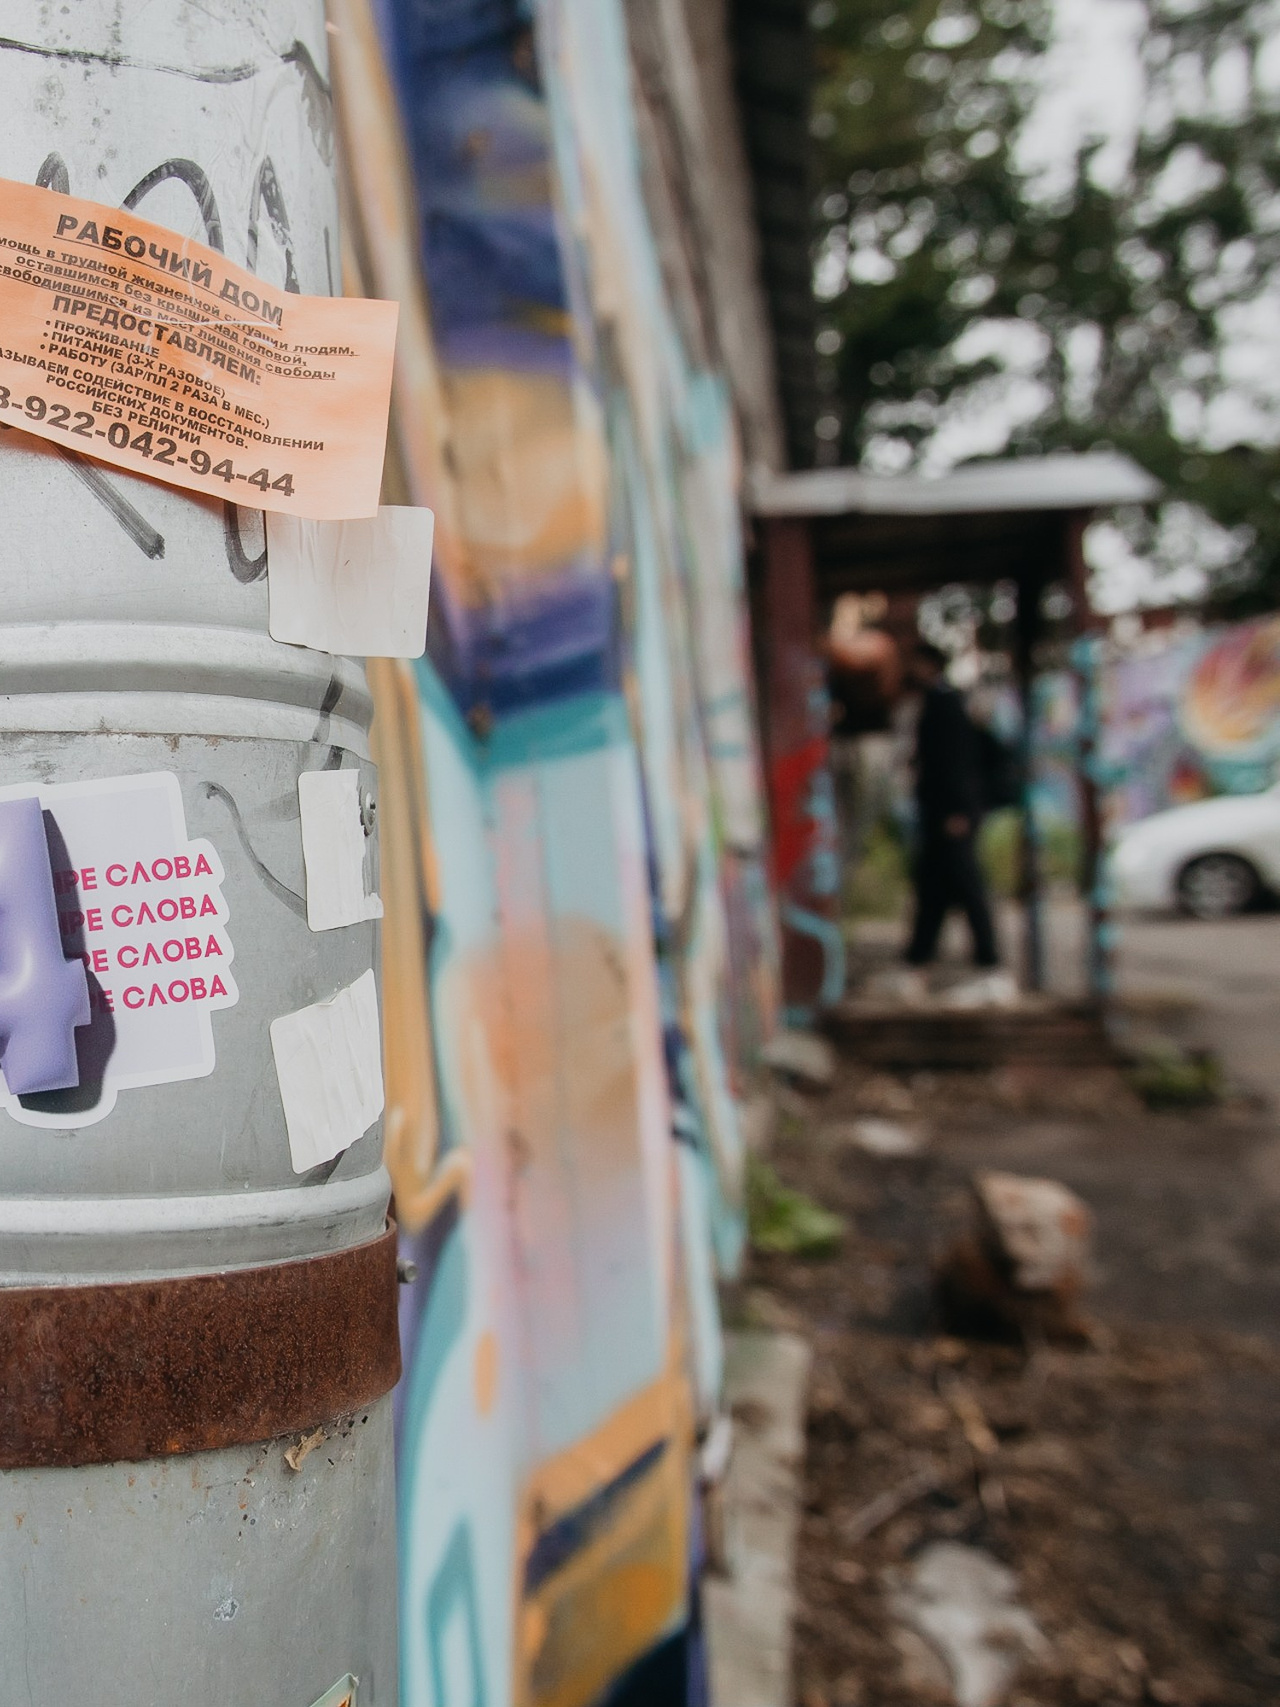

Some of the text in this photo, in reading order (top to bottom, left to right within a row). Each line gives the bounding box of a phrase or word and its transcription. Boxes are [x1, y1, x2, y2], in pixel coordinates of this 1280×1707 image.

[46, 249, 56, 259] в
[61, 252, 127, 279] трудной
[132, 274, 220, 317] жизненной
[224, 314, 289, 350] ситуации
[56, 214, 212, 289] РАБОЧИЙ
[220, 278, 283, 327] ДОМ
[16, 256, 308, 366] оставшимся без крыши над головой,
[52, 295, 262, 386] ПРЕДОСТАВЛЯЕМ:
[54, 320, 160, 358] ПРОЖИВАНИЕ
[132, 304, 153, 317] из
[157, 311, 195, 332] мест
[198, 328, 261, 367] лишения
[266, 361, 336, 379] свободы
[48, 343, 270, 430] РАБОТУ (ЗАР/ПЛ 2 РАЗА В МЕС.)
[51, 331, 123, 360] ПИТАНИЕ
[158, 364, 225, 399] РАЗОВОЕ)
[46, 375, 248, 449] РОССИЙСКИХ ДОКУМЕНТОВ.
[72, 369, 171, 407] СОДЕЙСТВИЕ
[174, 401, 184, 413] В
[188, 404, 324, 451] ВОССТАНОВЛЕНИИ
[92, 401, 201, 446] БЕЗ РЕЛИГИИ
[105, 853, 214, 890] СЛОВА
[111, 894, 219, 931] СЛОВА
[117, 934, 223, 971] СЛОВА
[123, 974, 228, 1011] СЛОВА
